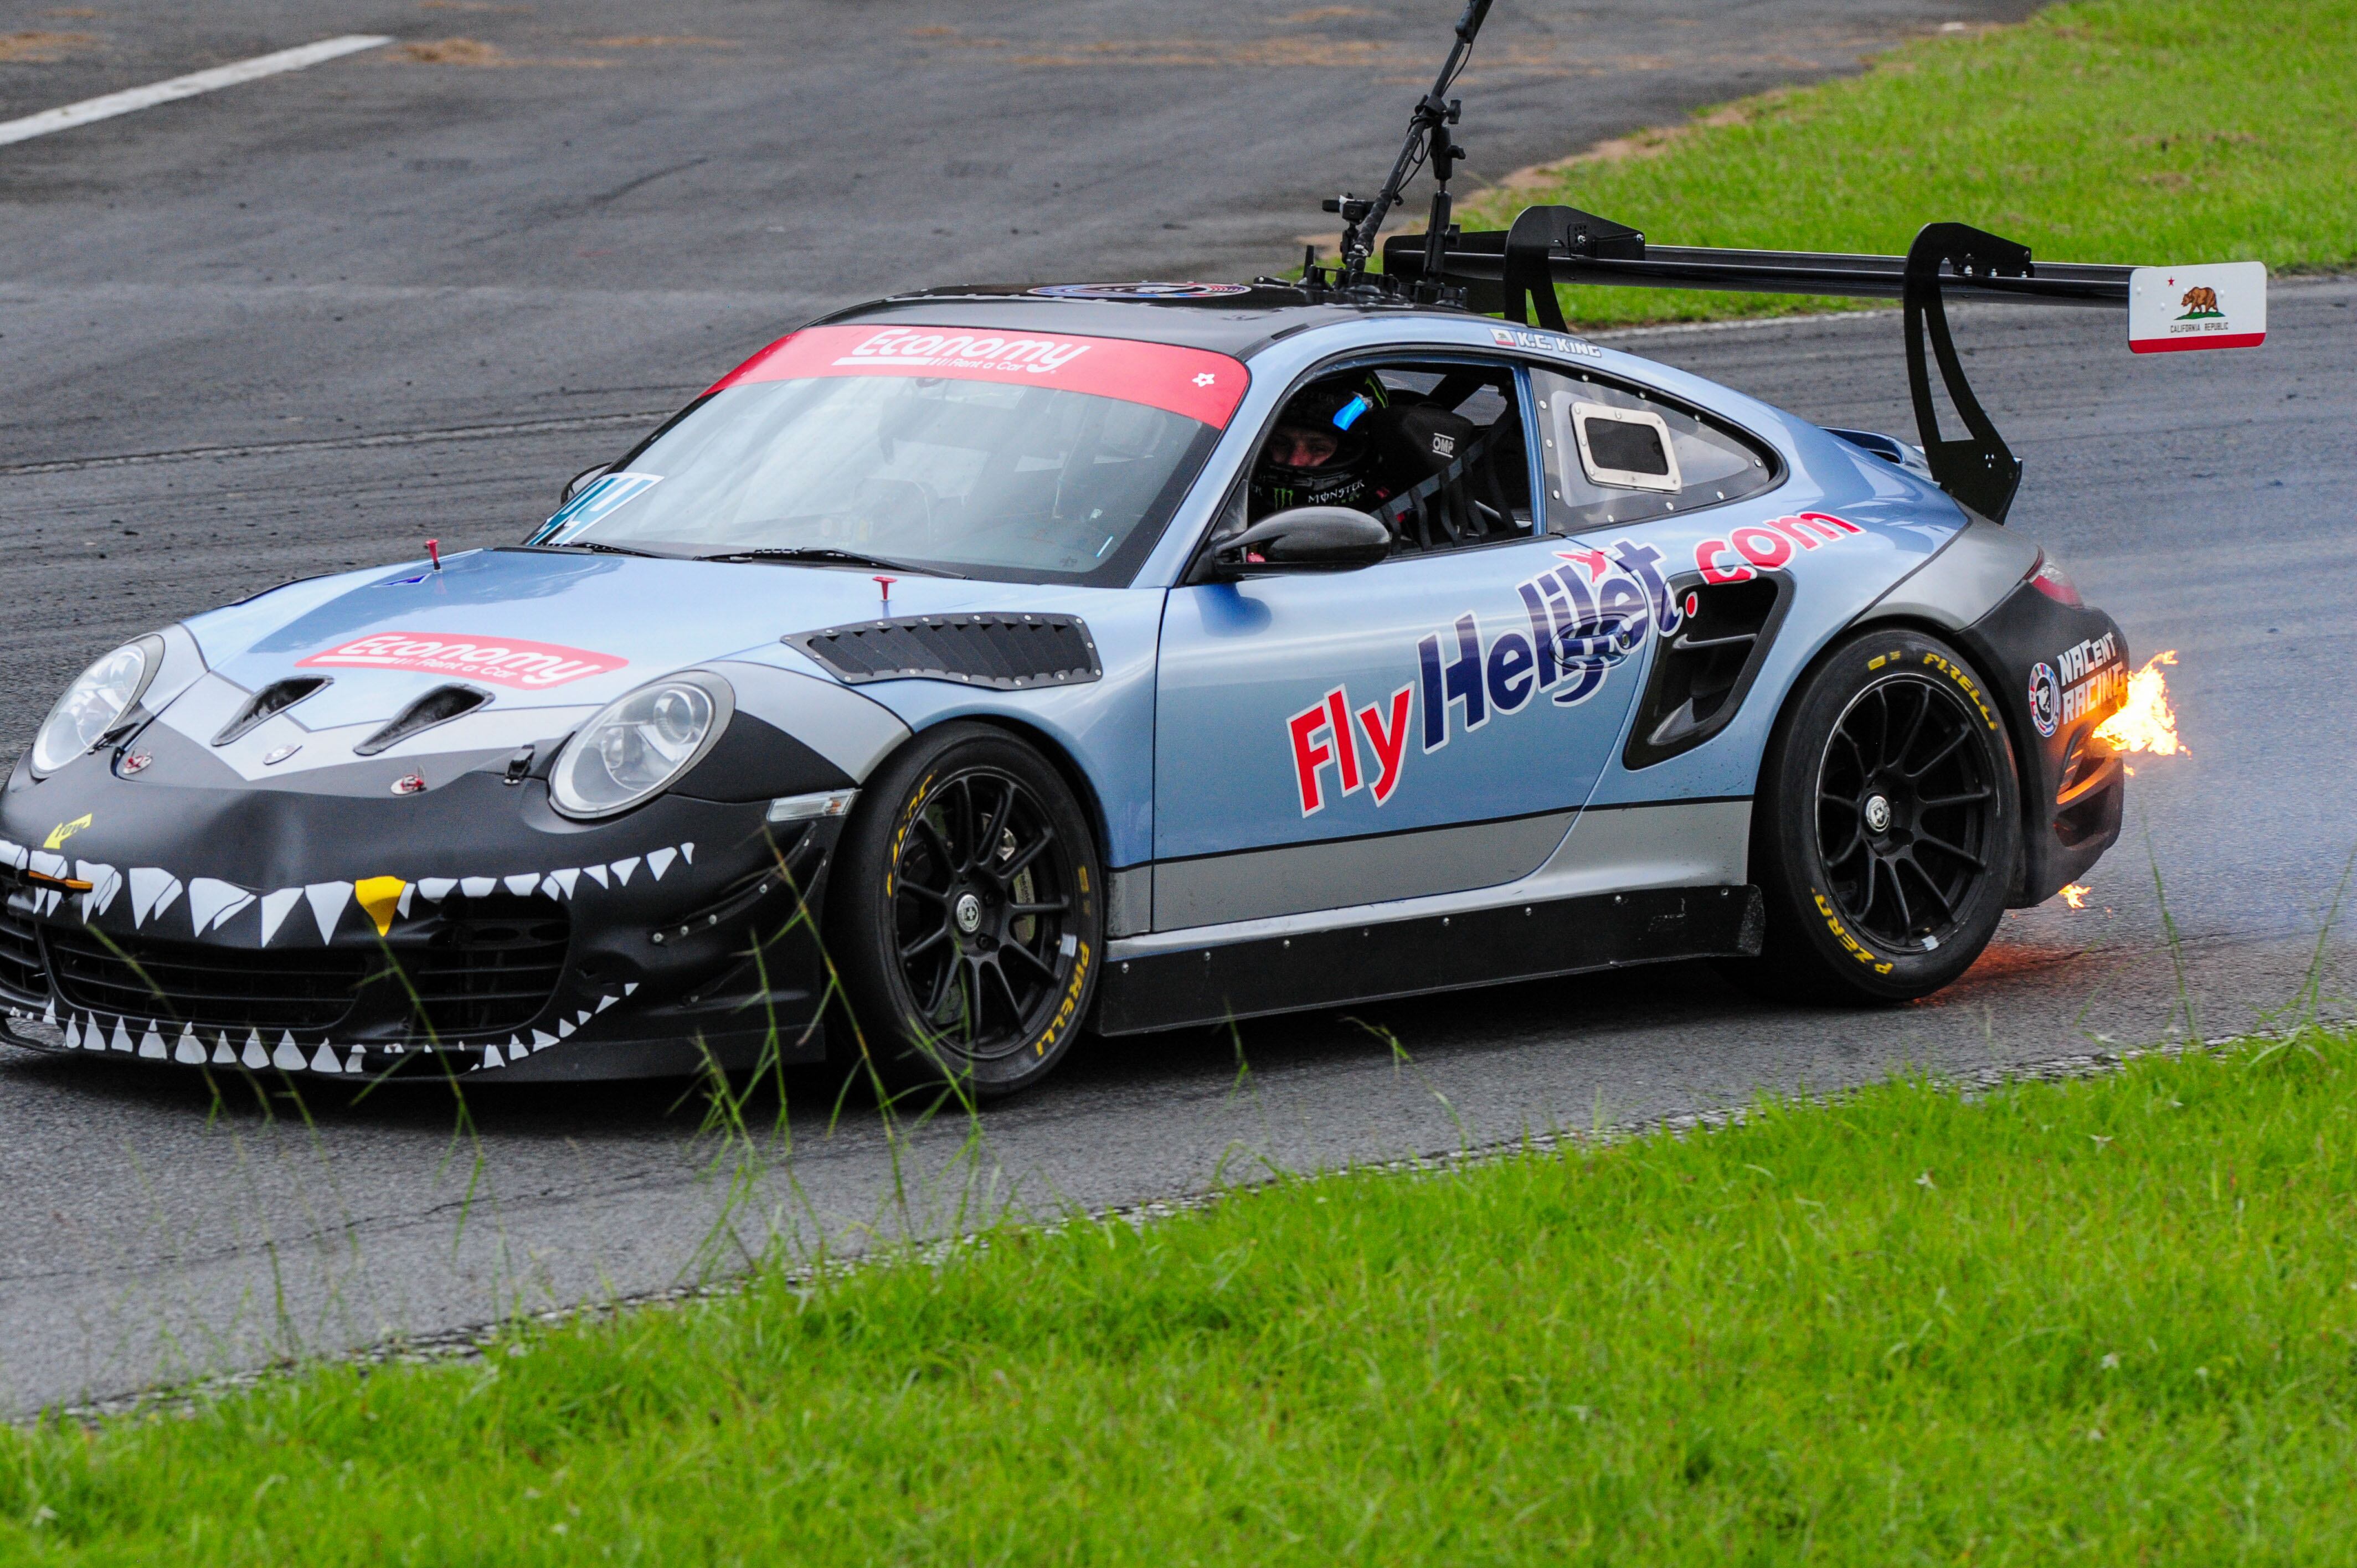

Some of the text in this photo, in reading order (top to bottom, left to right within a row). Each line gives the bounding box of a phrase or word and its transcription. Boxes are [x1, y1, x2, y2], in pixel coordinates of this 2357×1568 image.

[1516, 332, 1602, 358] K.C. KING
[2170, 322, 2229, 333] CALIFORNIA REPUBLIC
[852, 329, 1090, 373] Economy
[952, 358, 983, 368] Rent
[997, 361, 1023, 371] Car
[1433, 436, 1454, 454] OMP
[338, 636, 602, 684] Economy
[421, 658, 464, 669] Rent
[481, 666, 518, 678] Car
[1923, 653, 1998, 730] PIRELLI
[2062, 661, 2125, 725] RACING
[1036, 942, 1090, 1056] PIRELLI
